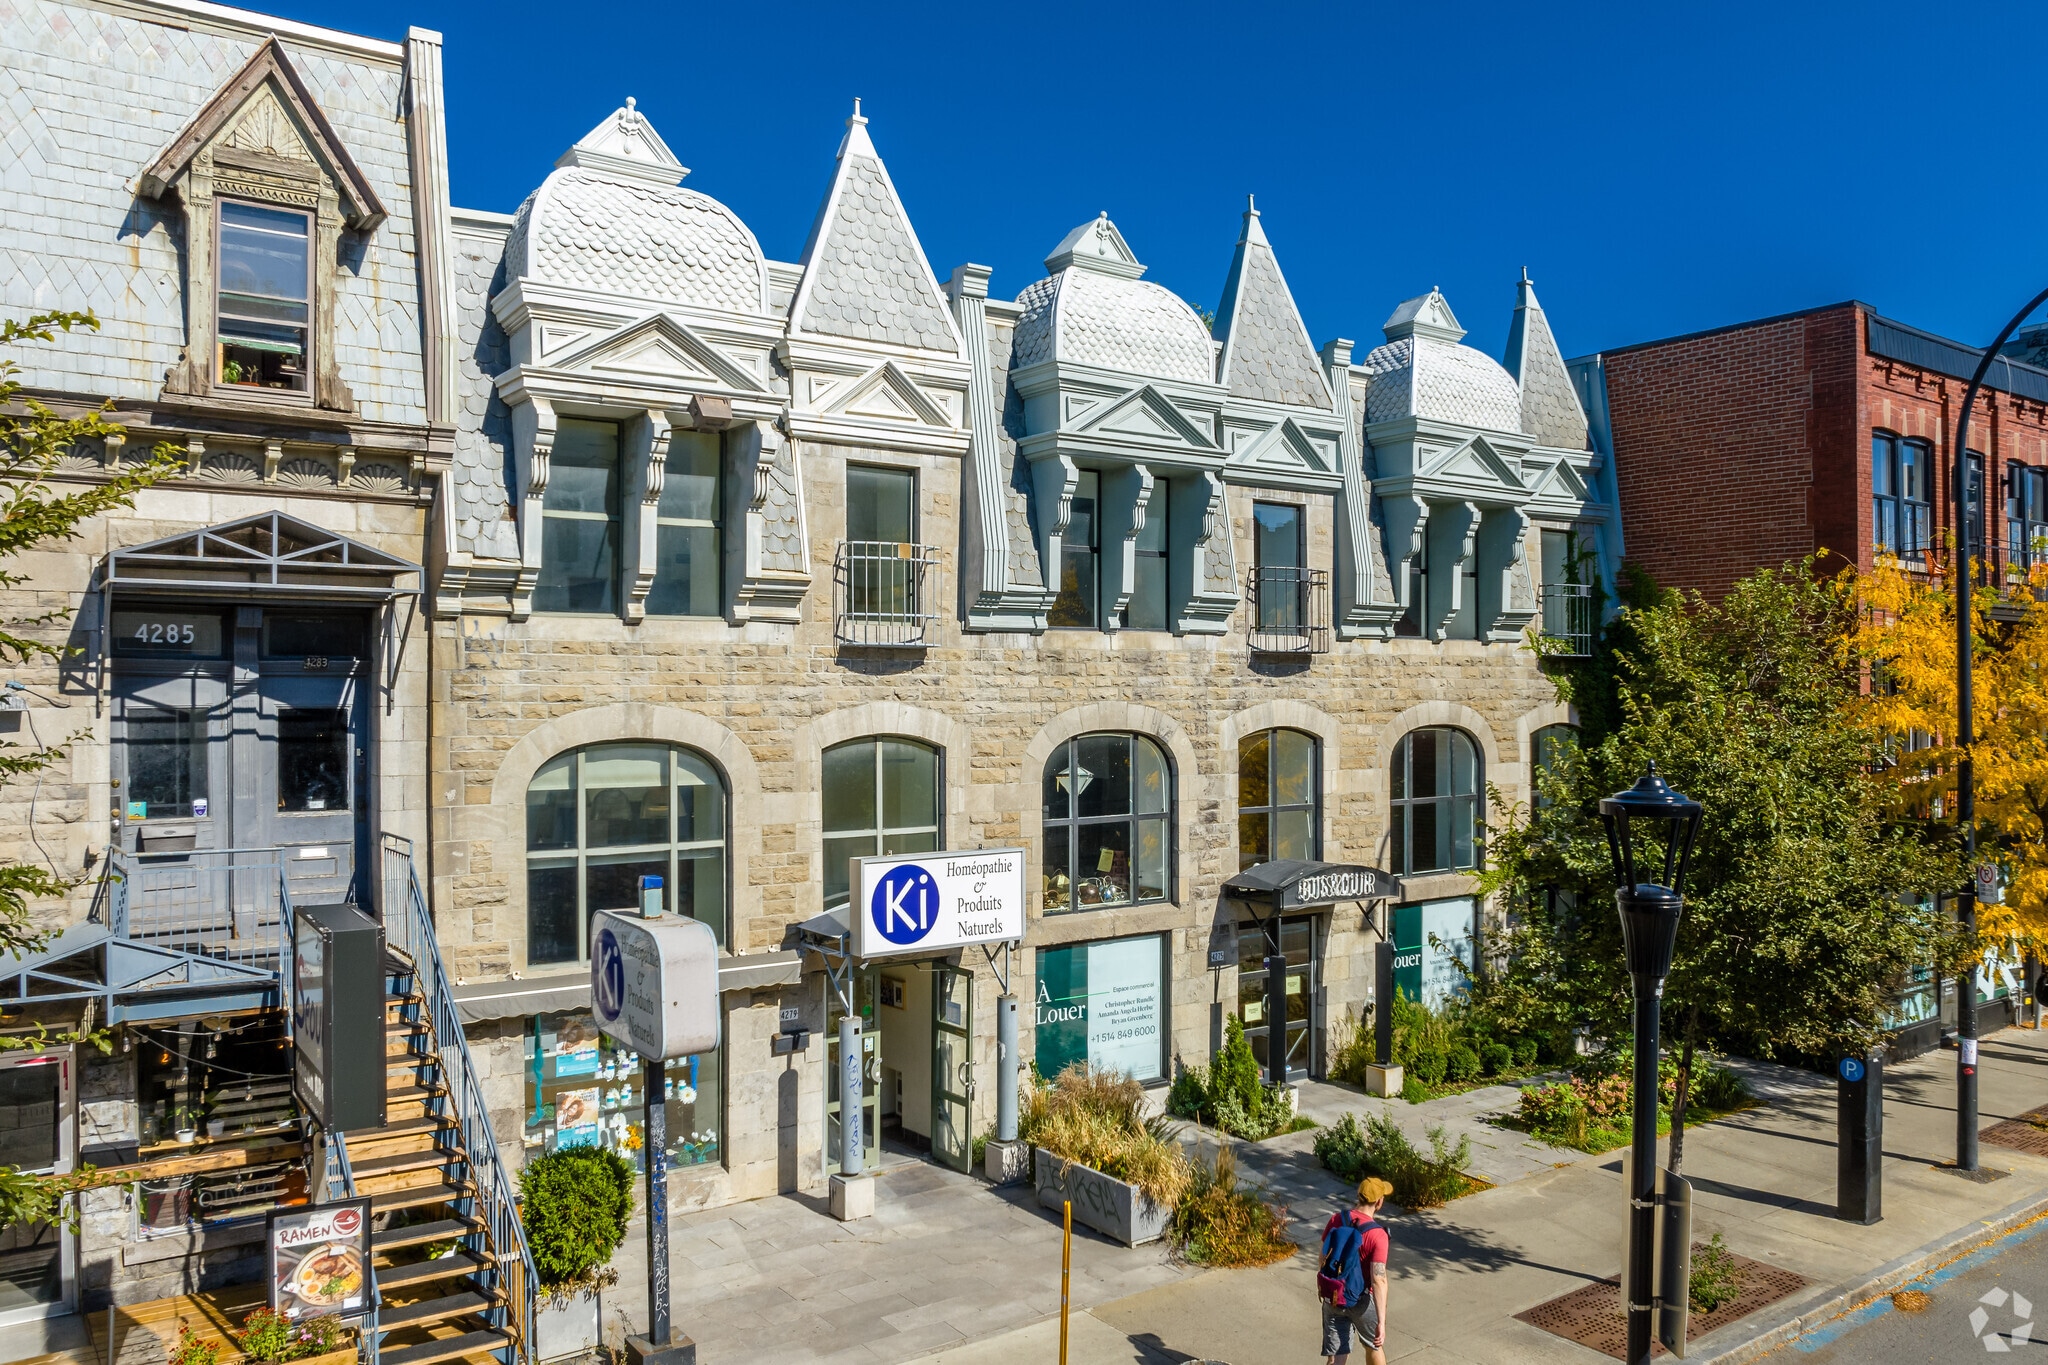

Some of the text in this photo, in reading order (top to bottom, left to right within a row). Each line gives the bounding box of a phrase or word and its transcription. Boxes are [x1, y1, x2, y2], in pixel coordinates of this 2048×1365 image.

[134, 623, 195, 644] 4285
[946, 858, 1013, 878] Homéopathie
[973, 881, 987, 893] &
[886, 874, 928, 934] Ki
[957, 895, 1002, 914] Produits
[958, 917, 1003, 937] Naturels
[1393, 953, 1421, 969] ouer
[598, 942, 619, 1010] Ki
[627, 984, 654, 1016] Produits
[1036, 979, 1052, 1004] À
[1130, 982, 1154, 990] commercial
[780, 1008, 798, 1019] 4279
[1098, 1009, 1119, 1018] Amanda
[1104, 999, 1136, 1009] Christopher
[1036, 1004, 1086, 1025] Louer
[628, 1014, 655, 1047] Naturels
[1091, 1025, 1156, 1043] +1 514 849 6000
[279, 1225, 331, 1244] RAMEN
